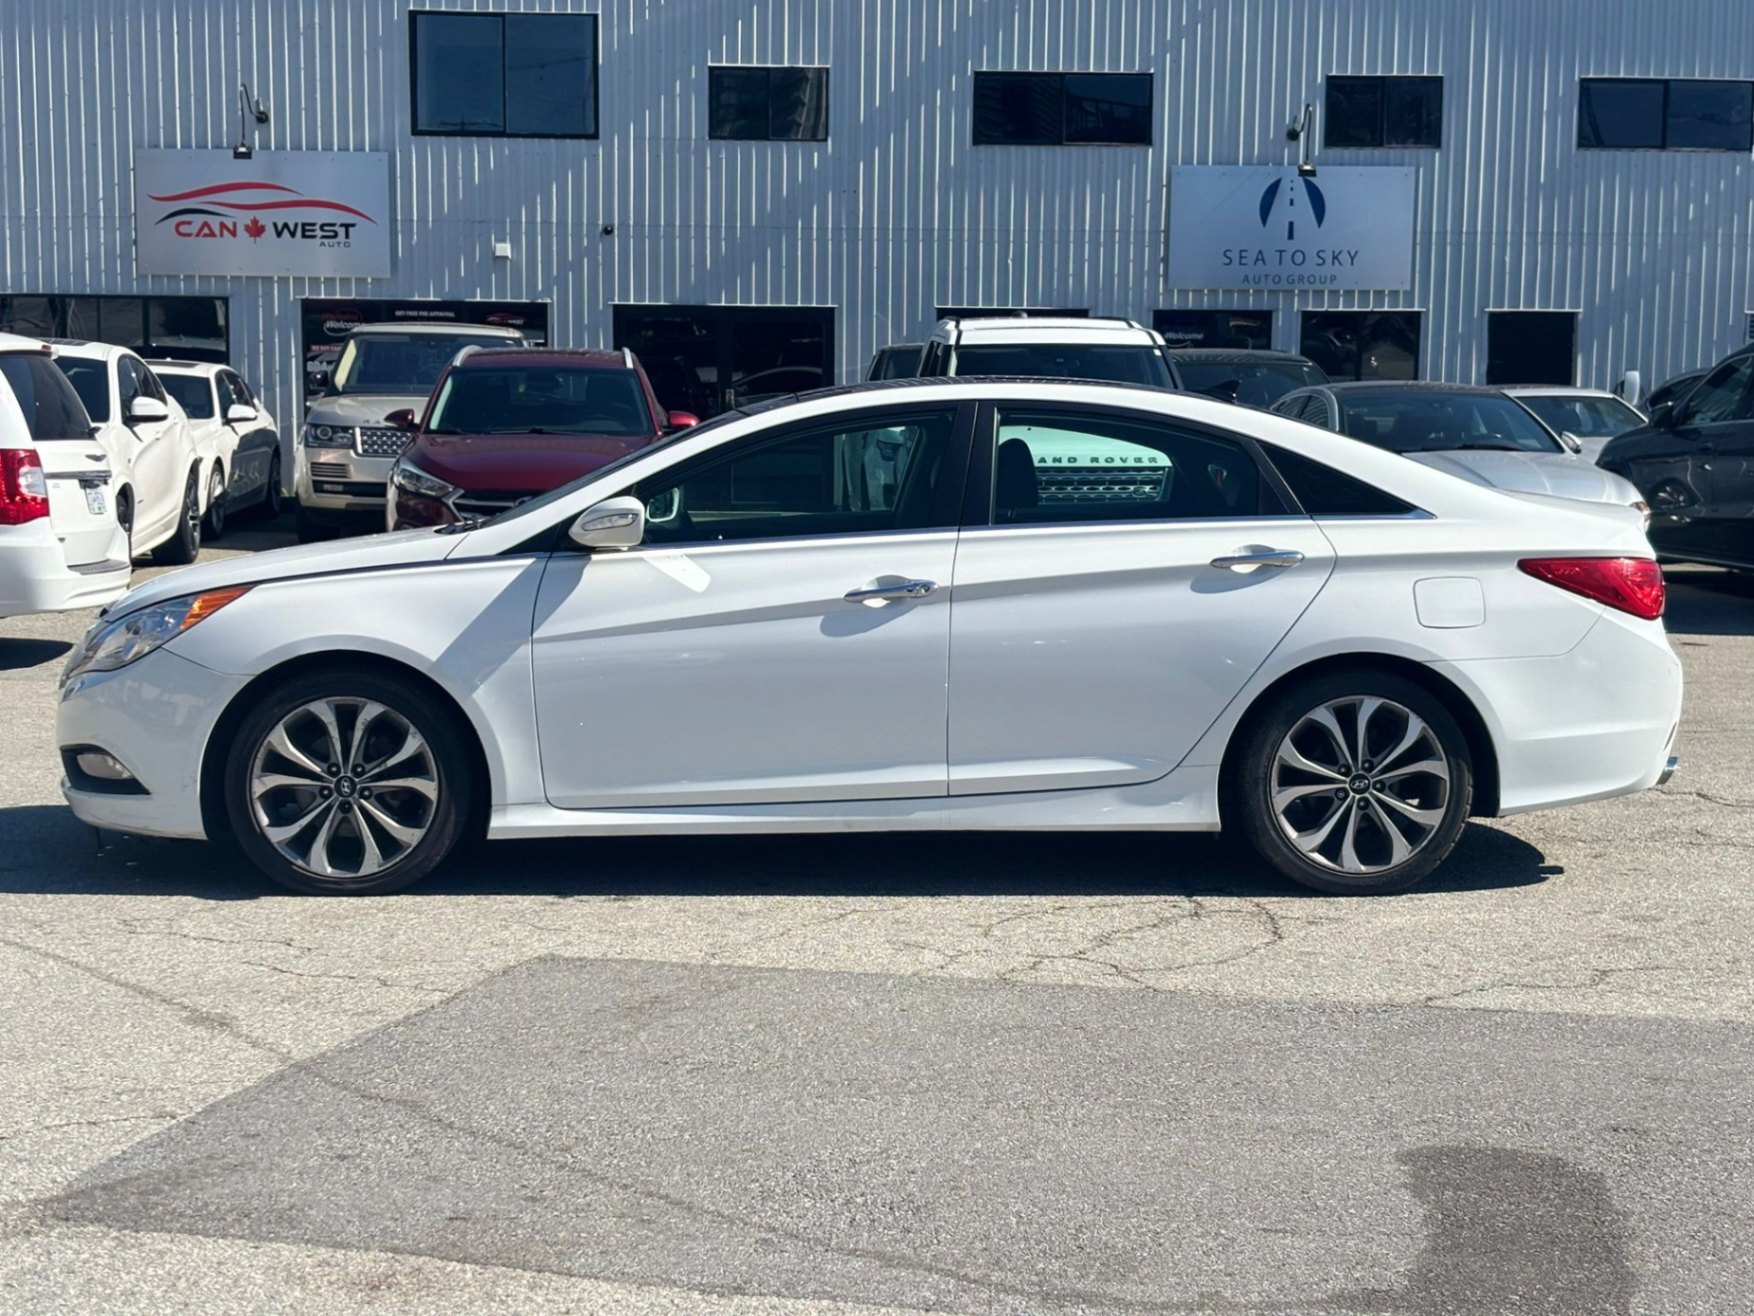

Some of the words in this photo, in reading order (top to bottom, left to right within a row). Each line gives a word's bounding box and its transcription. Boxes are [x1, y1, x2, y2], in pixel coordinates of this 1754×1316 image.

[174, 220, 237, 238] CAN
[272, 221, 357, 239] WEST
[1222, 249, 1266, 266] SEA
[1275, 249, 1306, 266] TO
[1315, 249, 1359, 266] SKY
[1241, 274, 1282, 285] AUTO
[1286, 274, 1337, 285] GROUP
[326, 320, 361, 329] Welcom
[1037, 456, 1078, 464] AND
[1090, 456, 1158, 464] ROVER
